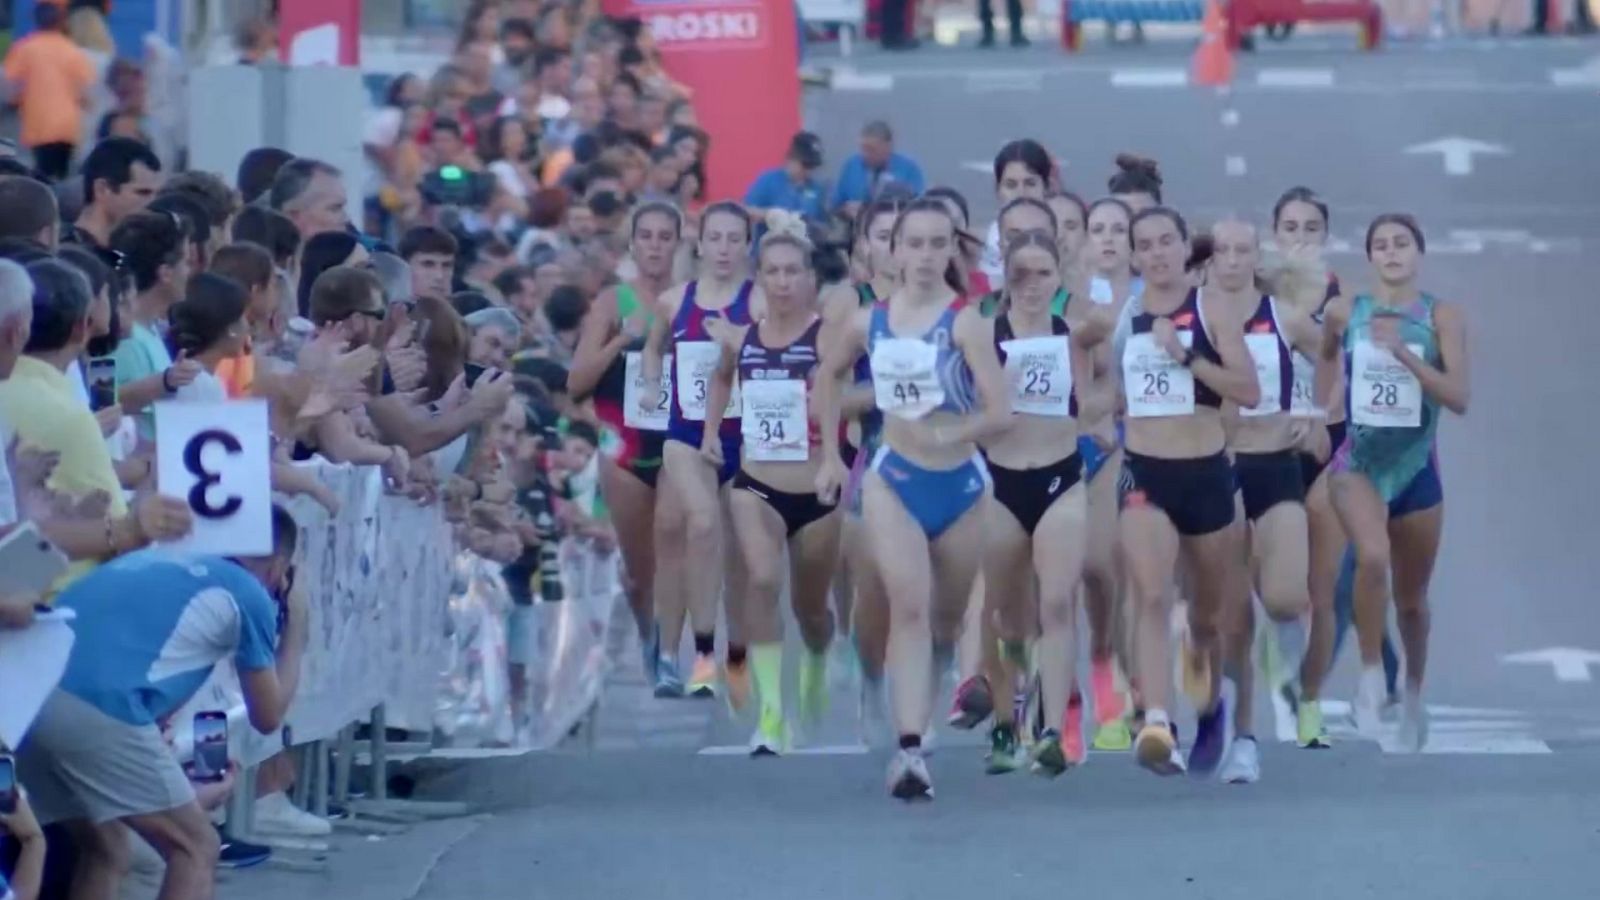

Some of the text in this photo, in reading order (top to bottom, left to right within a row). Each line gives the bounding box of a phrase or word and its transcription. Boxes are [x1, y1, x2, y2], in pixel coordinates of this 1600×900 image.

[649, 12, 757, 41] ROSKI
[694, 379, 706, 401] 3
[893, 382, 921, 402] 44
[1025, 369, 1051, 395] 25
[1143, 371, 1170, 395] 26
[657, 390, 670, 411] 2
[1370, 383, 1398, 406] 28
[759, 419, 786, 442] 34
